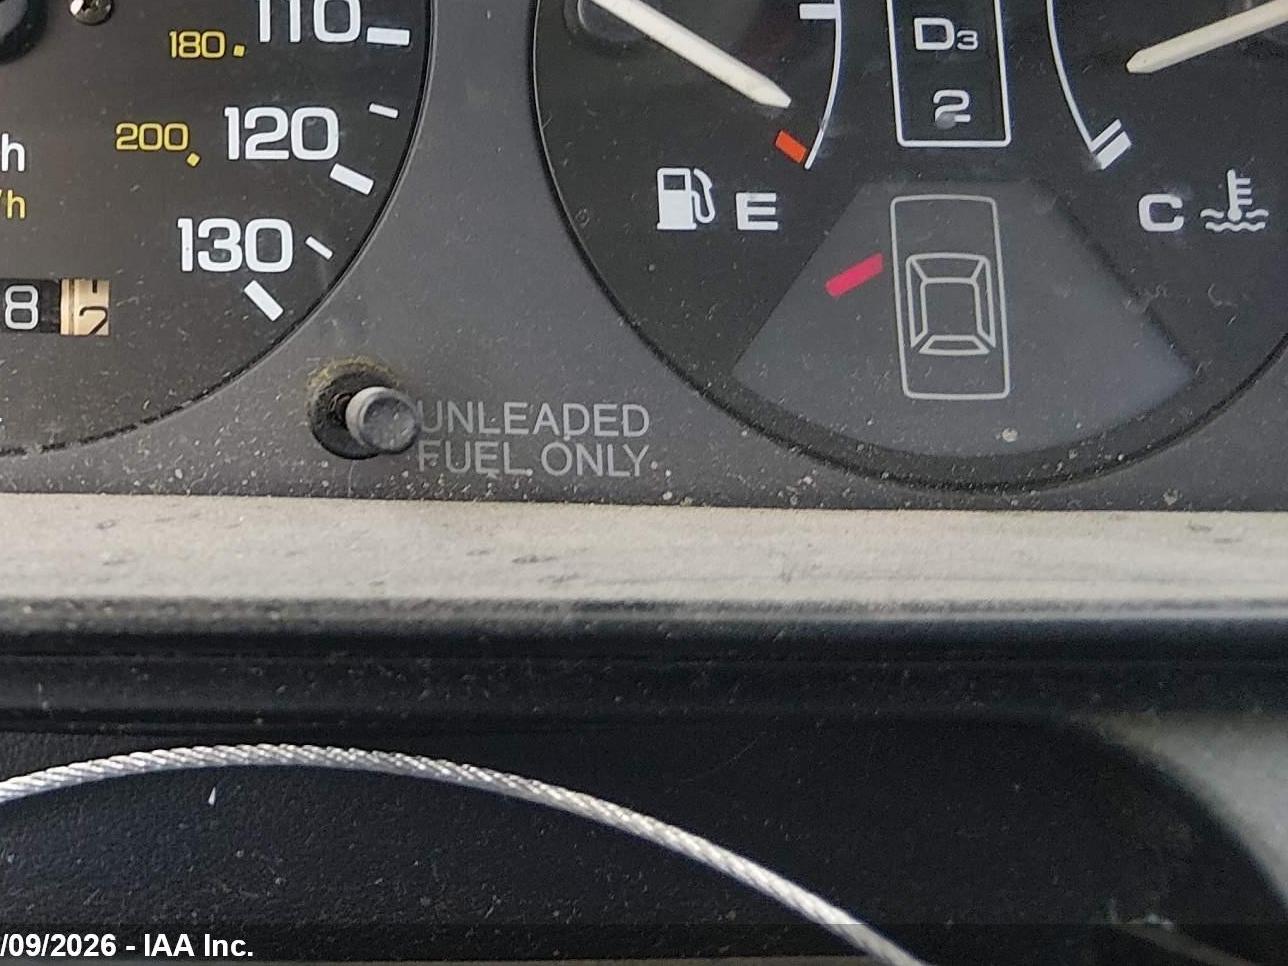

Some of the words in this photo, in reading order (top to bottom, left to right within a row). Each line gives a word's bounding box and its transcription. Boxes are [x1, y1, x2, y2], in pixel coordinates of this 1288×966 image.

[169, 30, 226, 59] 180
[932, 89, 971, 126] 2
[115, 122, 189, 151] 200
[223, 106, 340, 161] 120
[737, 192, 779, 231] E
[1138, 193, 1185, 232] C
[177, 217, 294, 273] 130
[415, 400, 651, 438] UNLEADED
[417, 439, 529, 475] FUEL
[540, 441, 650, 477] ONLY
